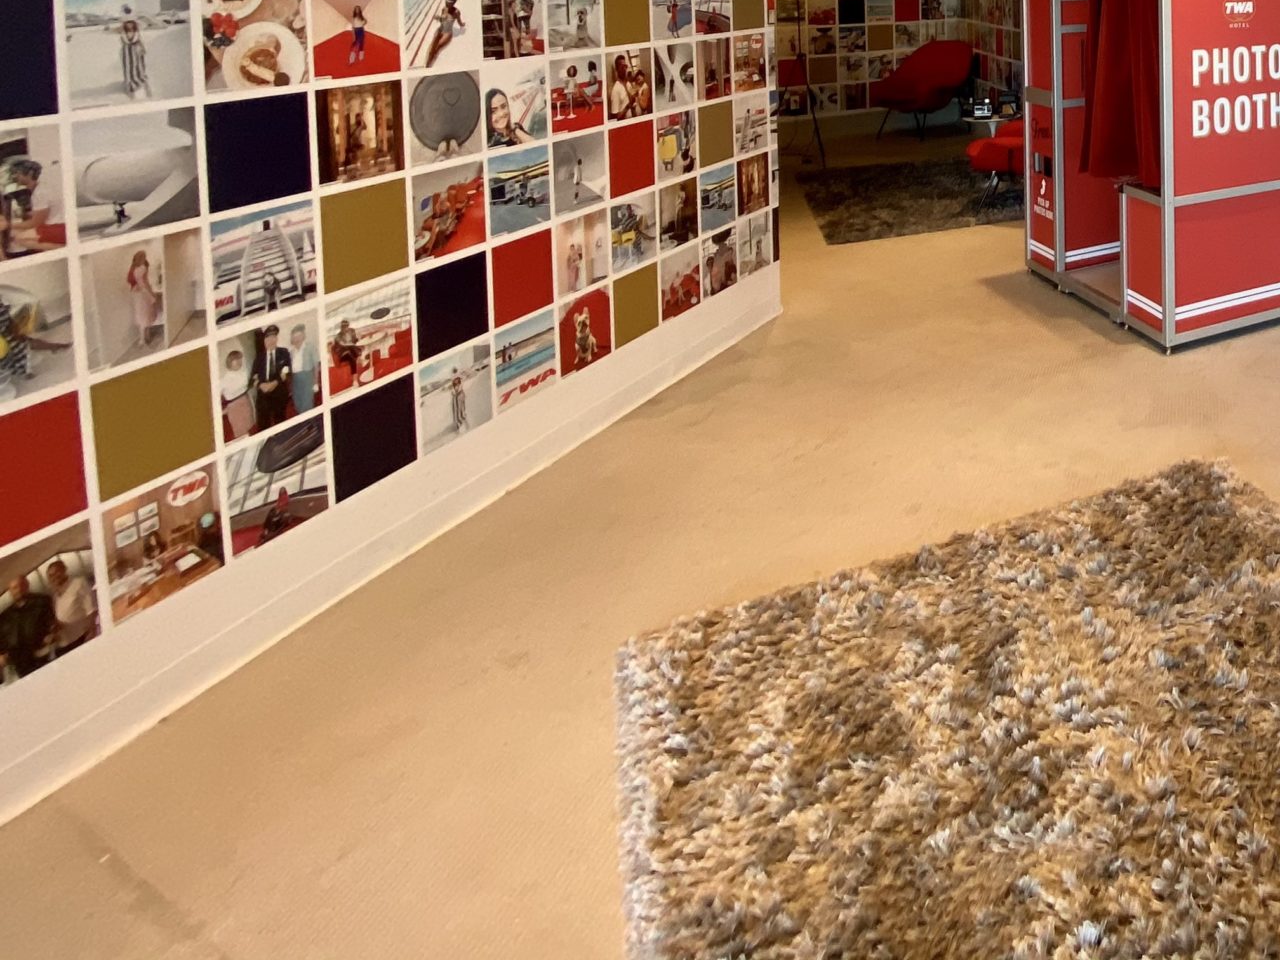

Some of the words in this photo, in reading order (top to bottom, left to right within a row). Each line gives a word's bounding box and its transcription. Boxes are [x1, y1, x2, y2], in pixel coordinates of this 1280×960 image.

[1224, 1, 1254, 15] TWA
[499, 368, 557, 407] TWA
[170, 474, 208, 502] TWA
